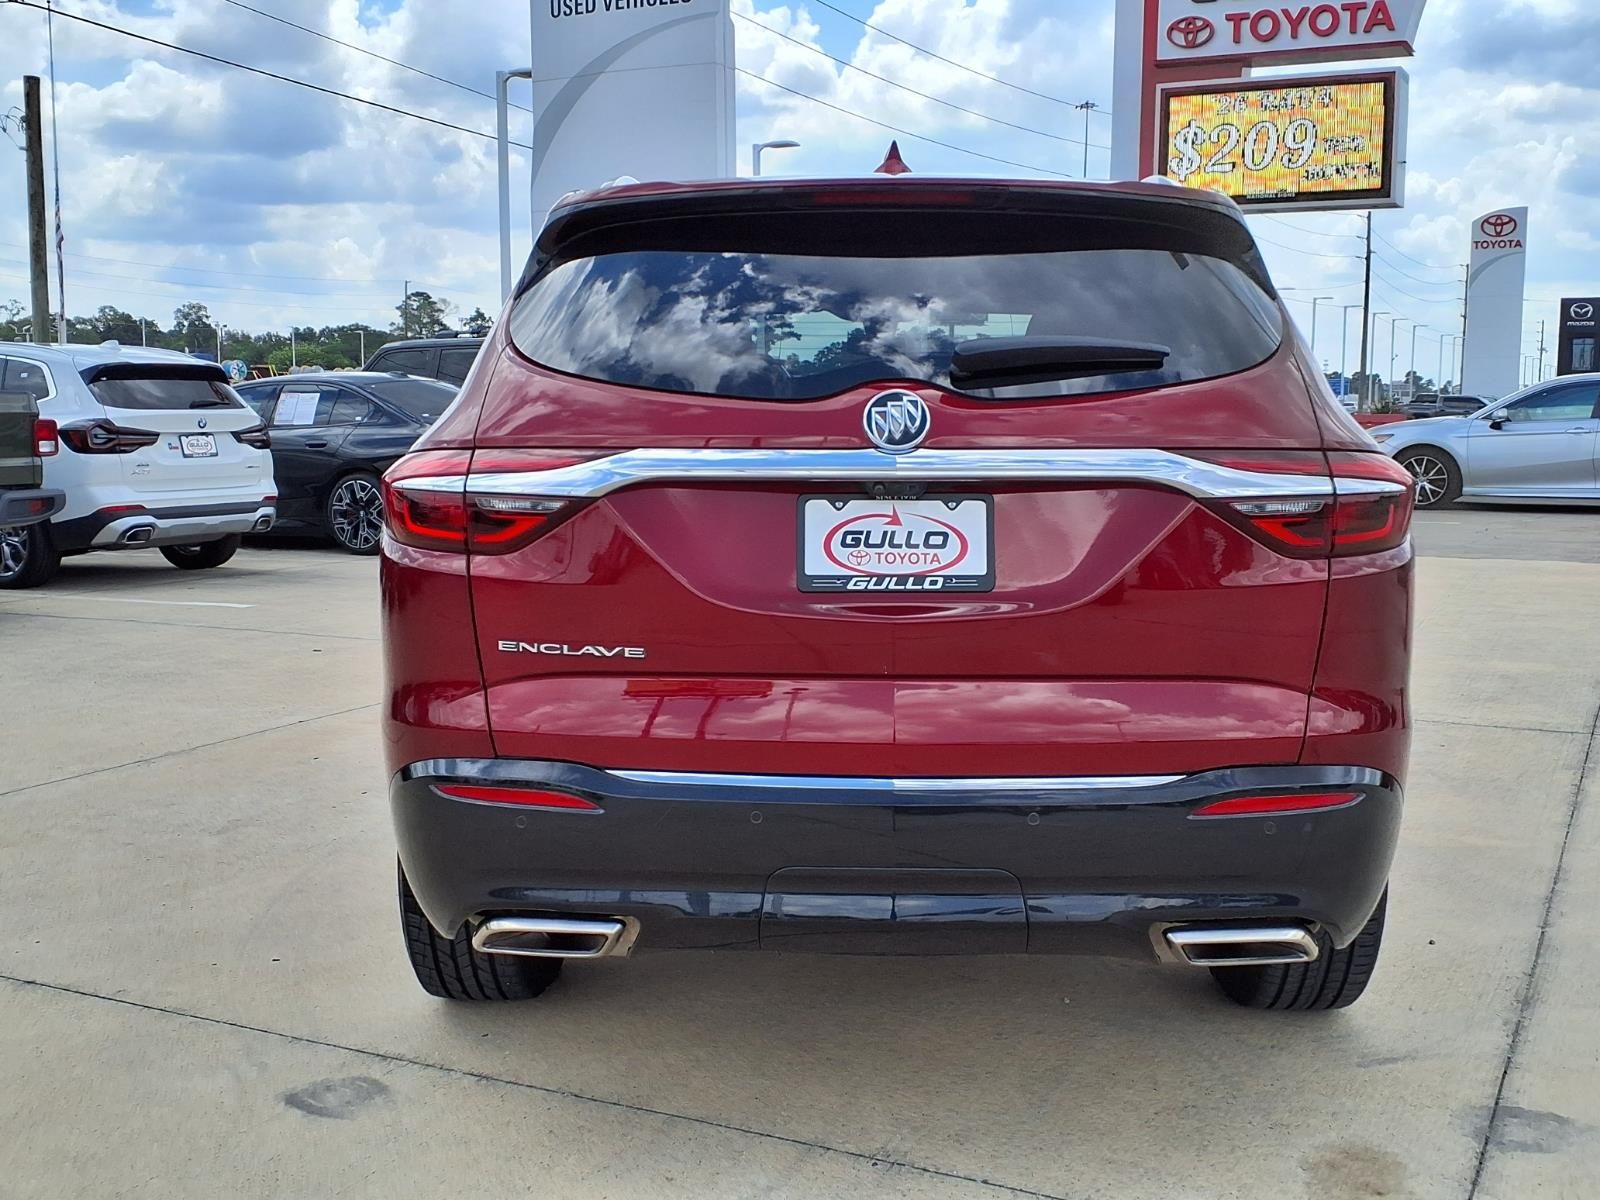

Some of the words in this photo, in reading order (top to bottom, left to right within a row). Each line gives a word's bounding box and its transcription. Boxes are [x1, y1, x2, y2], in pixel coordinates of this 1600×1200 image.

[550, 0, 596, 18] USED
[1225, 0, 1395, 43] TOYOTA
[1168, 118, 1318, 181] $209
[1473, 240, 1522, 249] TOYOTA
[840, 530, 950, 550] GULLO
[874, 552, 941, 565] TOYOTA
[846, 576, 944, 590] GULLO
[498, 640, 646, 659] ENCLAVE
